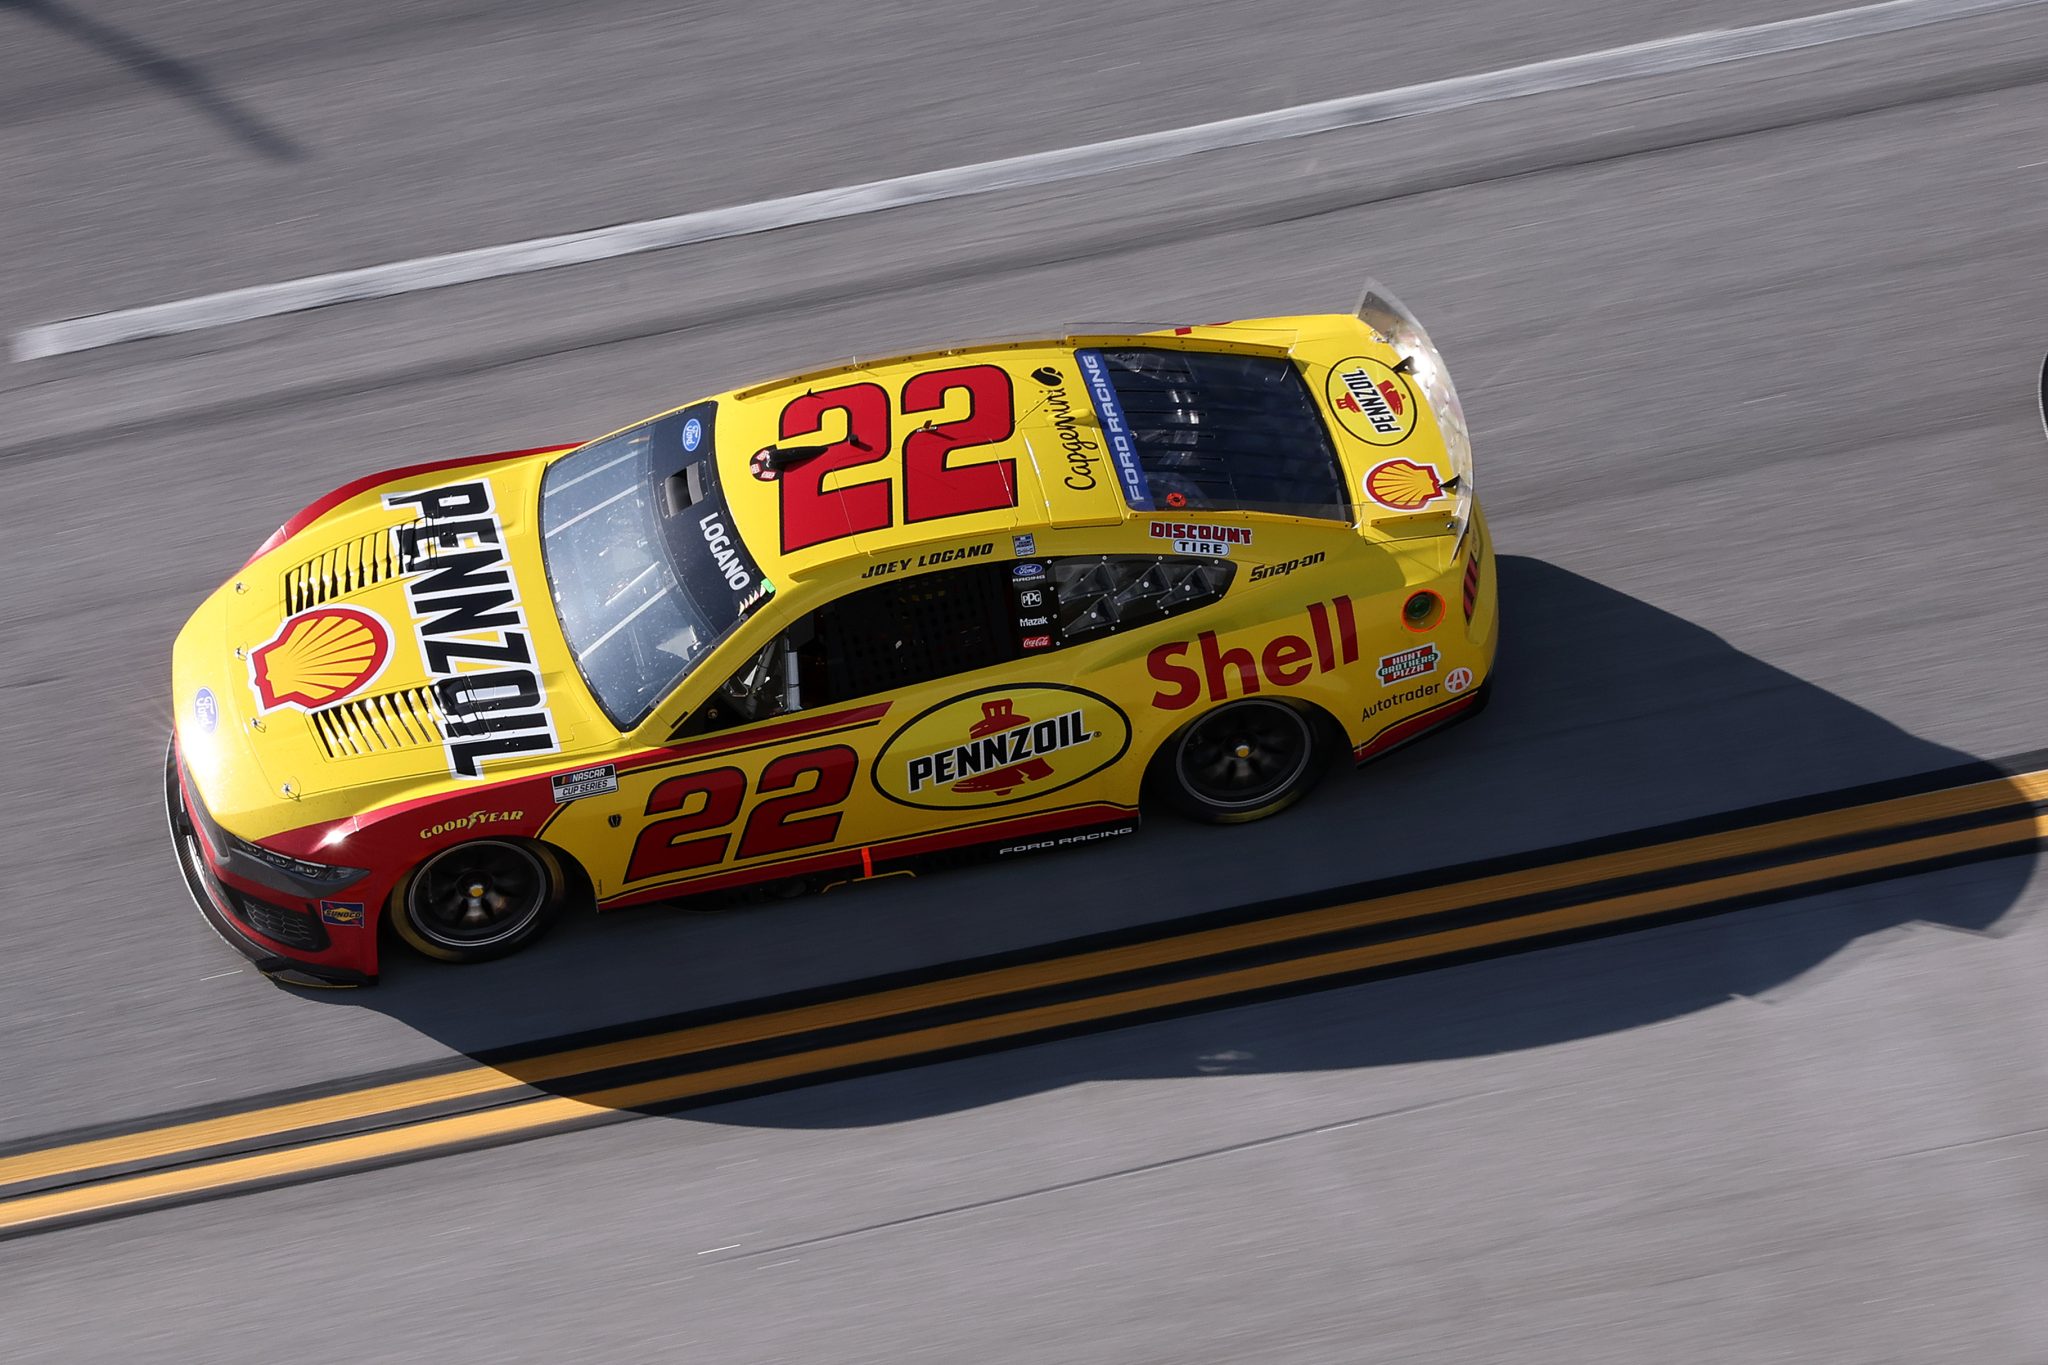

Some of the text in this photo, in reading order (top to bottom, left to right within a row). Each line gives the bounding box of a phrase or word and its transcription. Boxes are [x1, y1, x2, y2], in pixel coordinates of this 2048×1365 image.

[1341, 368, 1403, 434] PENNZOIL
[685, 422, 700, 447] Ford
[1040, 386, 1099, 491] Capgemini
[1083, 354, 1145, 502] FORD RACING
[778, 364, 1018, 556] 22
[1151, 522, 1252, 545] DISCOUNT
[1179, 541, 1223, 554] TIRE
[699, 512, 750, 591] LOGANO
[862, 557, 912, 579] JOEY
[918, 542, 994, 567] LOGANO
[1249, 552, 1325, 583] Snap-on
[1022, 592, 1041, 605] PPG
[384, 480, 559, 779] PENNZOIL
[1019, 616, 1048, 627] Mazak
[1146, 595, 1359, 710] Shell
[1381, 654, 1435, 676] BROTHERS
[1392, 650, 1423, 665] HUNT
[1393, 664, 1425, 679] PIZZA
[196, 692, 216, 732] Ford
[1361, 682, 1441, 722] Autotrader
[907, 708, 1093, 794] PENNZOIL
[561, 779, 609, 798] CUP SERIES
[572, 769, 606, 783] NASCAR
[419, 810, 525, 840] GOODYEAR
[623, 743, 859, 885] 22
[999, 827, 1132, 854] FORD RACING
[326, 909, 361, 918] SUNOCO
